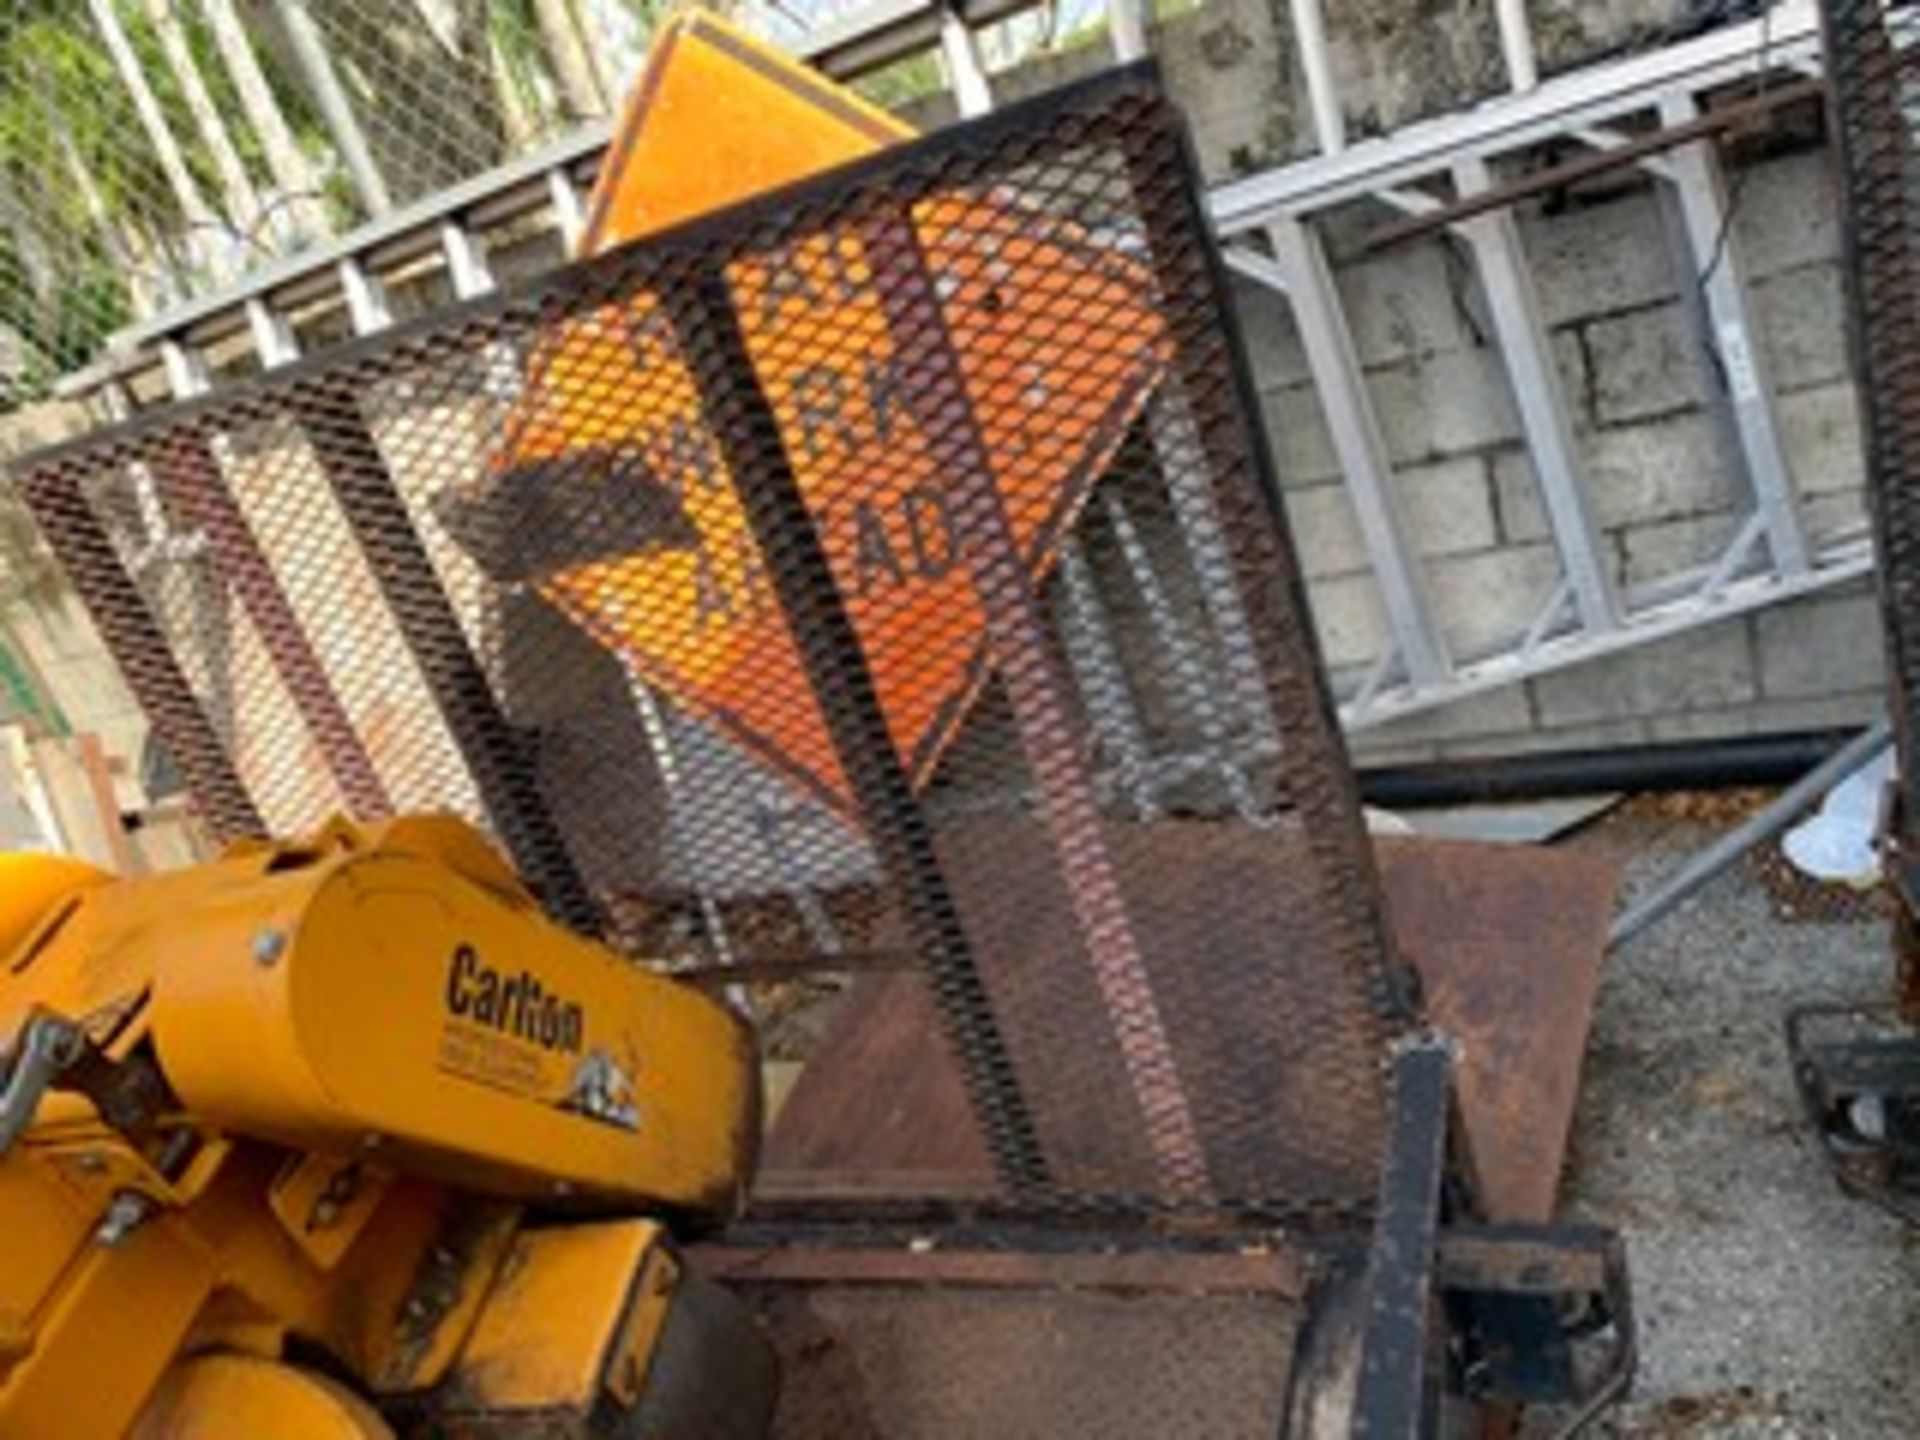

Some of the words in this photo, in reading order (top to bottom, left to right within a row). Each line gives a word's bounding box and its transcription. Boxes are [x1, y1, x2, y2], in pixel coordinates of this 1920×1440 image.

[630, 216, 886, 370] RAD
[640, 348, 930, 490] WRK
[692, 488, 960, 628] AHAD
[447, 940, 584, 1056] Carlton
